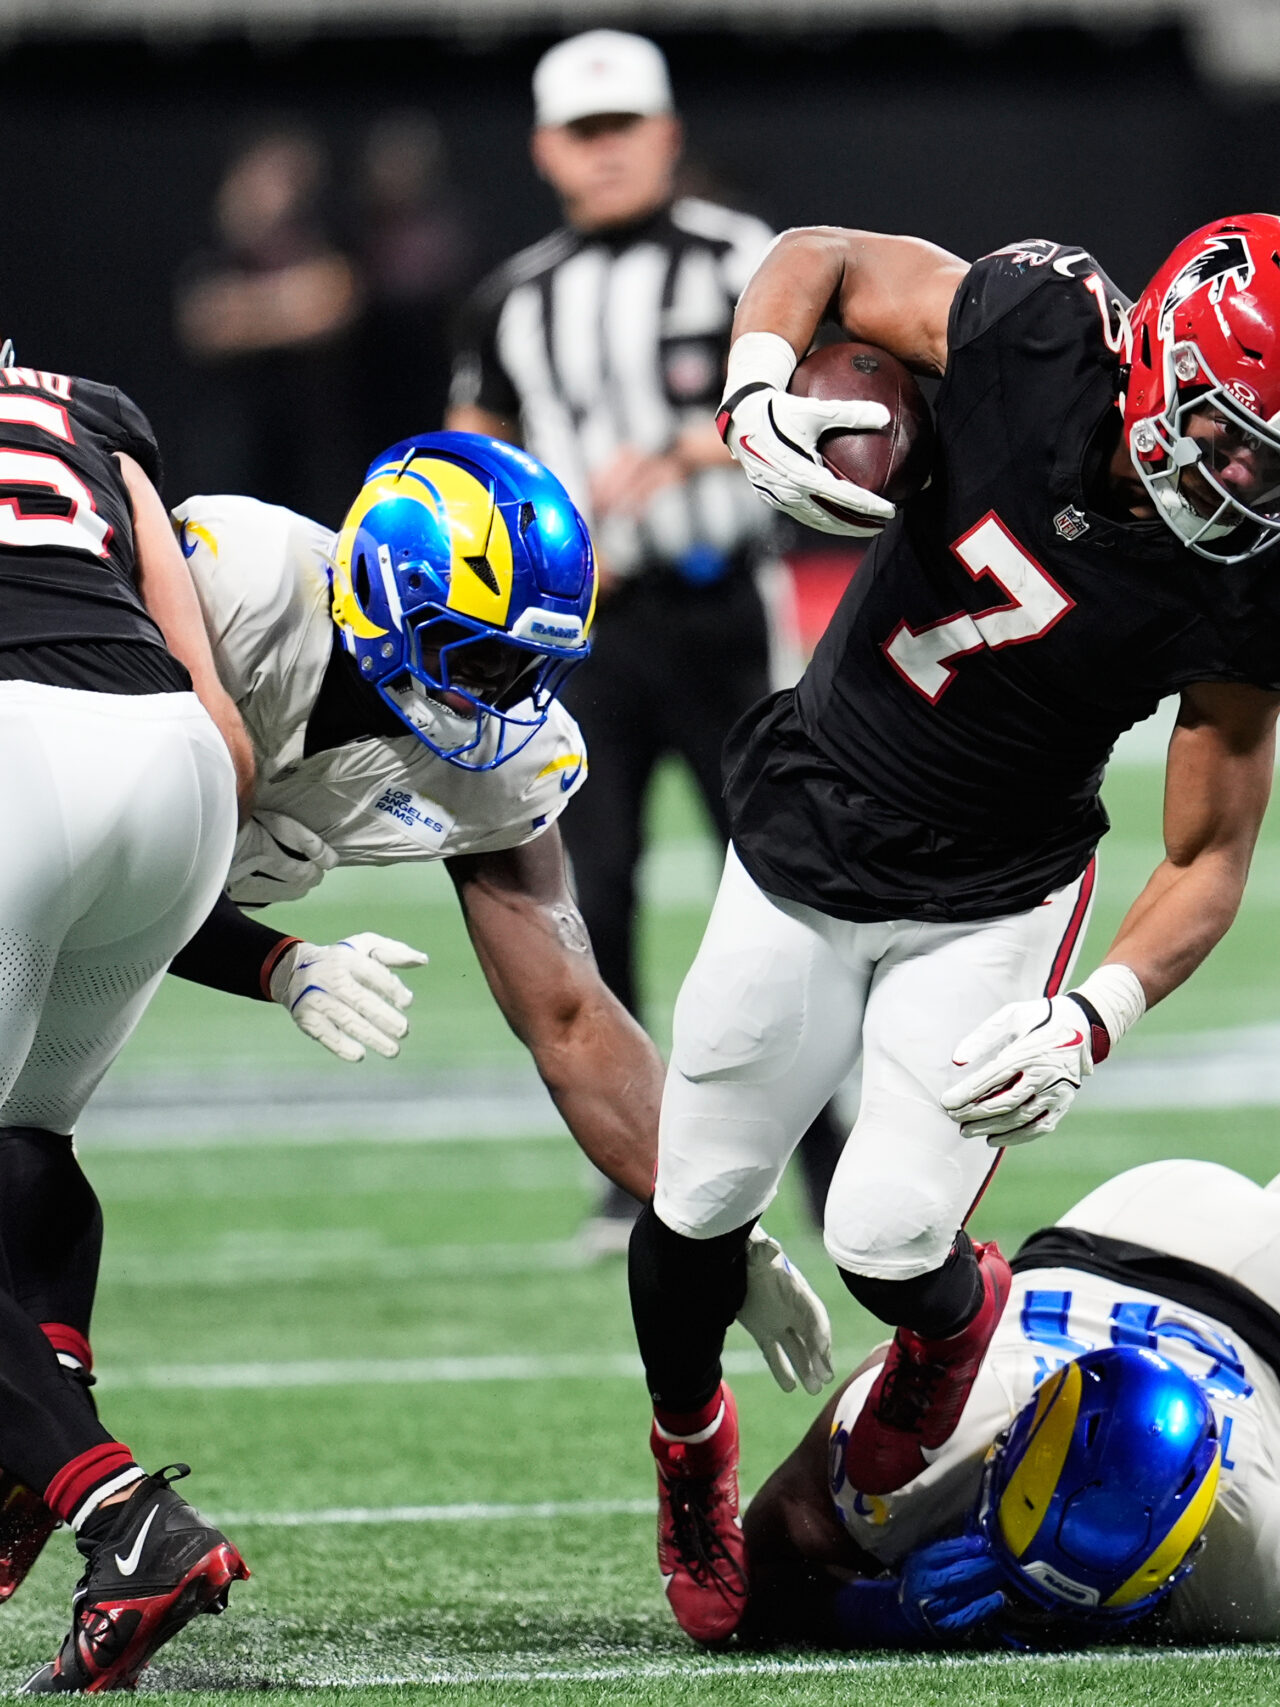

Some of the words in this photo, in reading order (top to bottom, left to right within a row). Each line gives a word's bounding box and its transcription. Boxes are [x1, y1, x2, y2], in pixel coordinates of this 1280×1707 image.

[882, 509, 1076, 706] 7
[385, 788, 413, 803] LOS
[374, 801, 414, 827] RAMS
[379, 795, 443, 833] ANGELES
